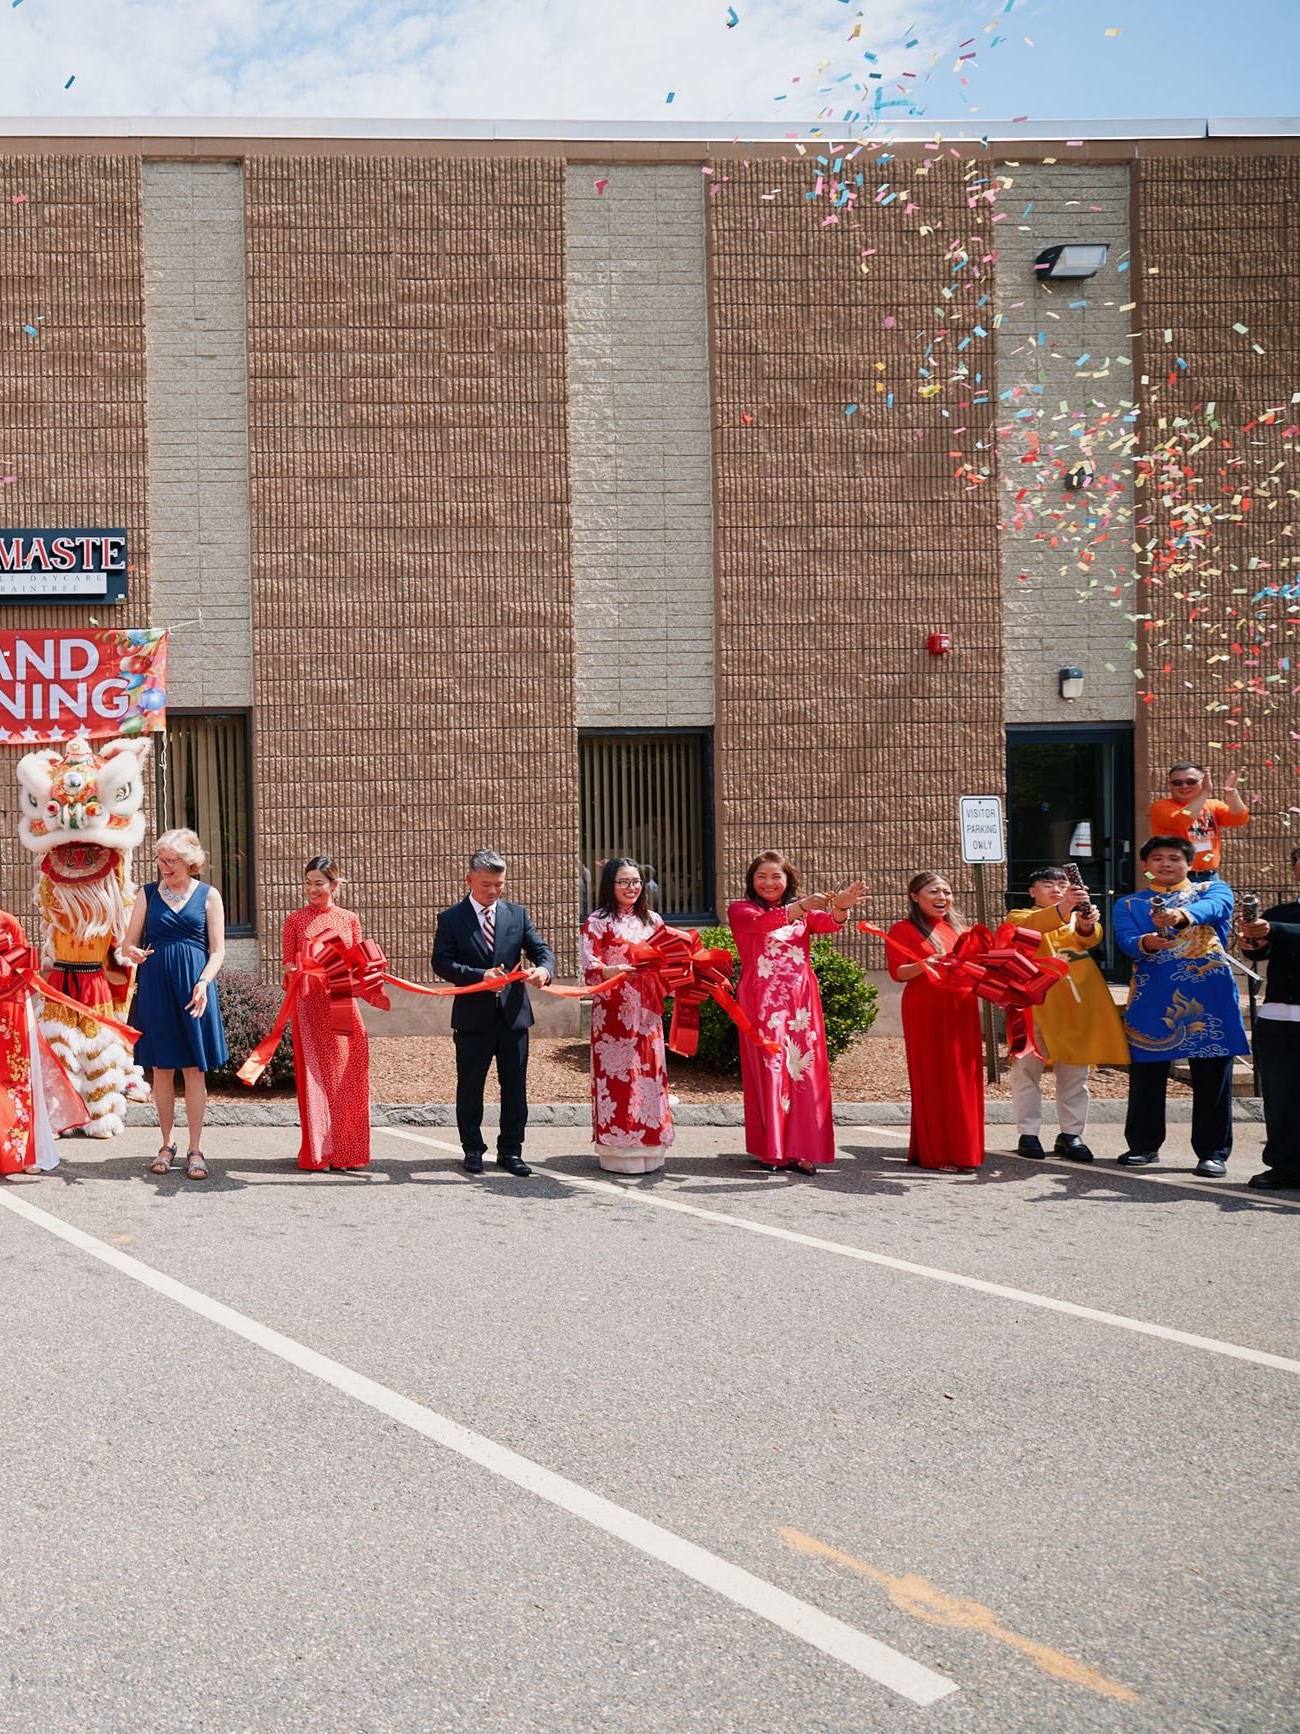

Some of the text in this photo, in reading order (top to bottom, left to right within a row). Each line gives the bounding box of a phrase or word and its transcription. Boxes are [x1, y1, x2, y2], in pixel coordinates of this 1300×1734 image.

[30, 574, 102, 583] DAYCARE
[966, 808, 996, 818] VISITOR
[966, 824, 998, 834] PARKING
[973, 840, 993, 850] ONLY
